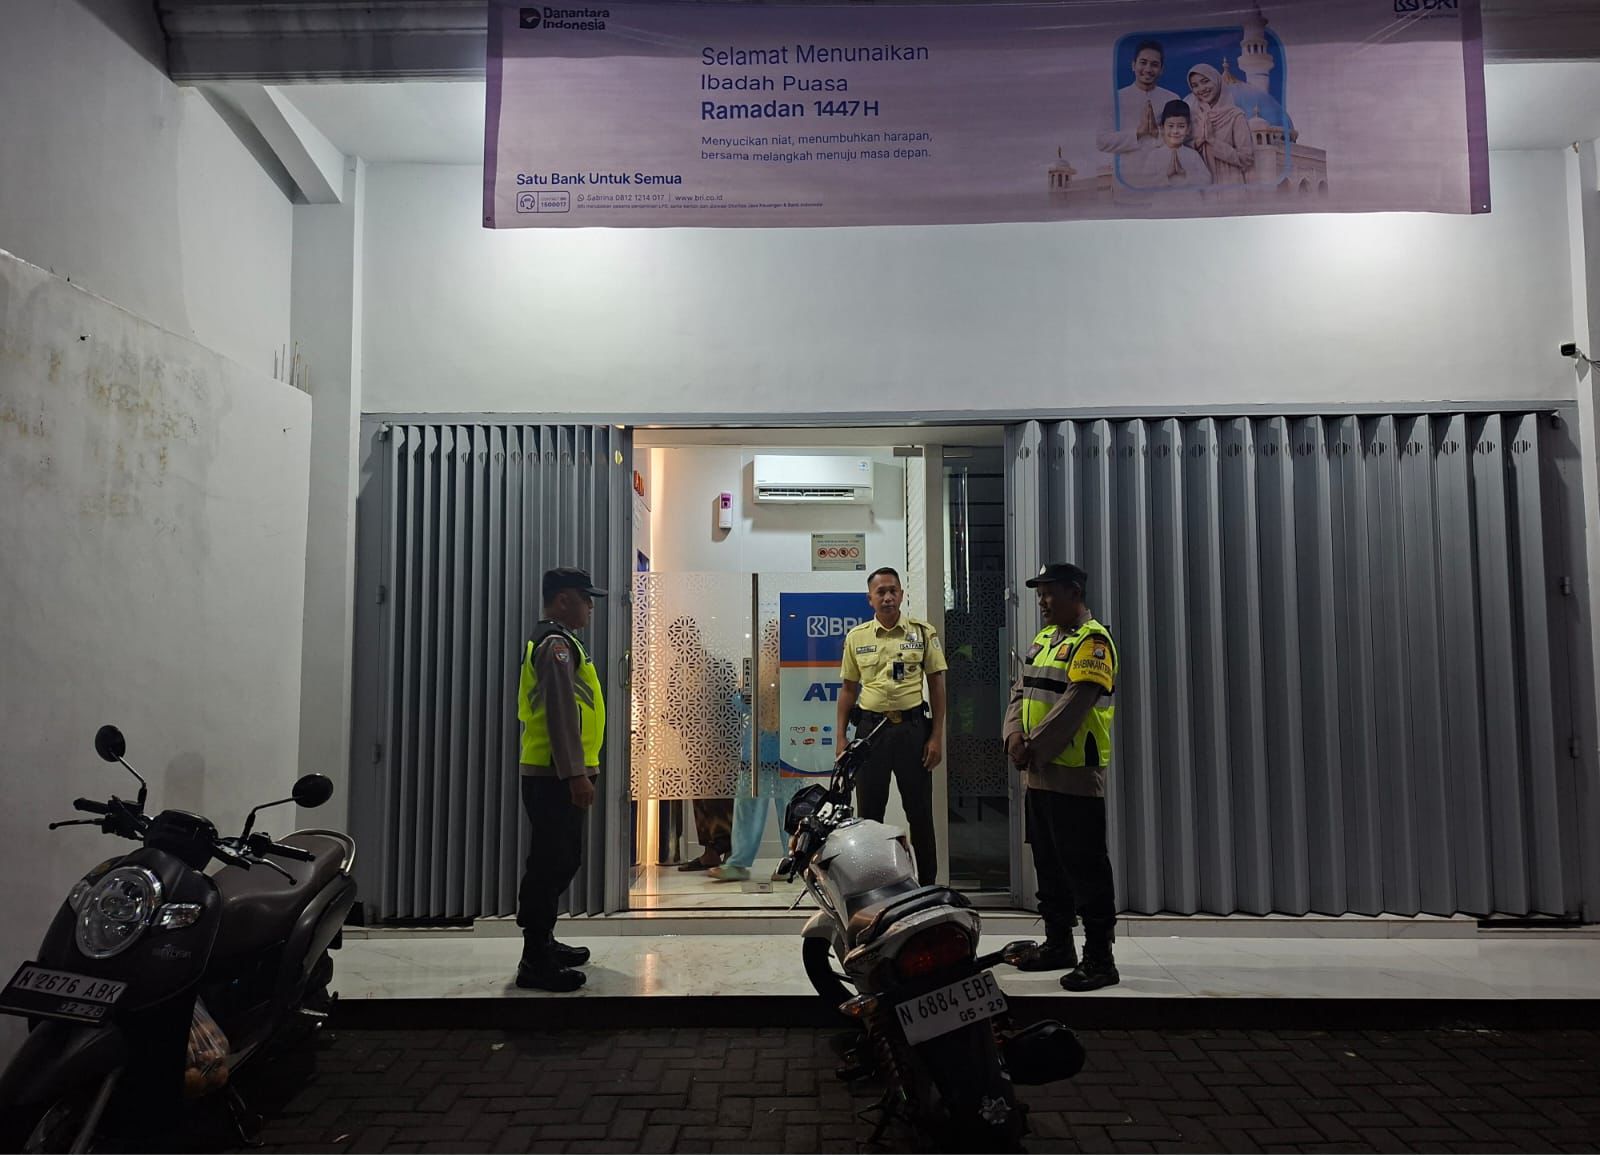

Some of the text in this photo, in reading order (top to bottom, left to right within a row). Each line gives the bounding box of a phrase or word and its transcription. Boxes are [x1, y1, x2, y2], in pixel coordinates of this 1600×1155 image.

[543, 7, 610, 19] Danantara
[543, 19, 606, 31] Indonesia
[701, 44, 929, 66] Selamat Menunaikan
[701, 74, 849, 92] Ibadah Puasa
[701, 100, 805, 120] Ramadan
[701, 131, 933, 148] Menyucikan niat, menumbuhkan harapan,
[701, 148, 932, 165] bersama melangkah menuju masa depan.
[516, 172, 683, 186] Satu Bank Untuk Semua
[829, 617, 862, 636] BR
[803, 683, 844, 701] AT
[19, 971, 121, 1001] N 2676 ABK
[899, 975, 993, 1026] N 6884 EBF
